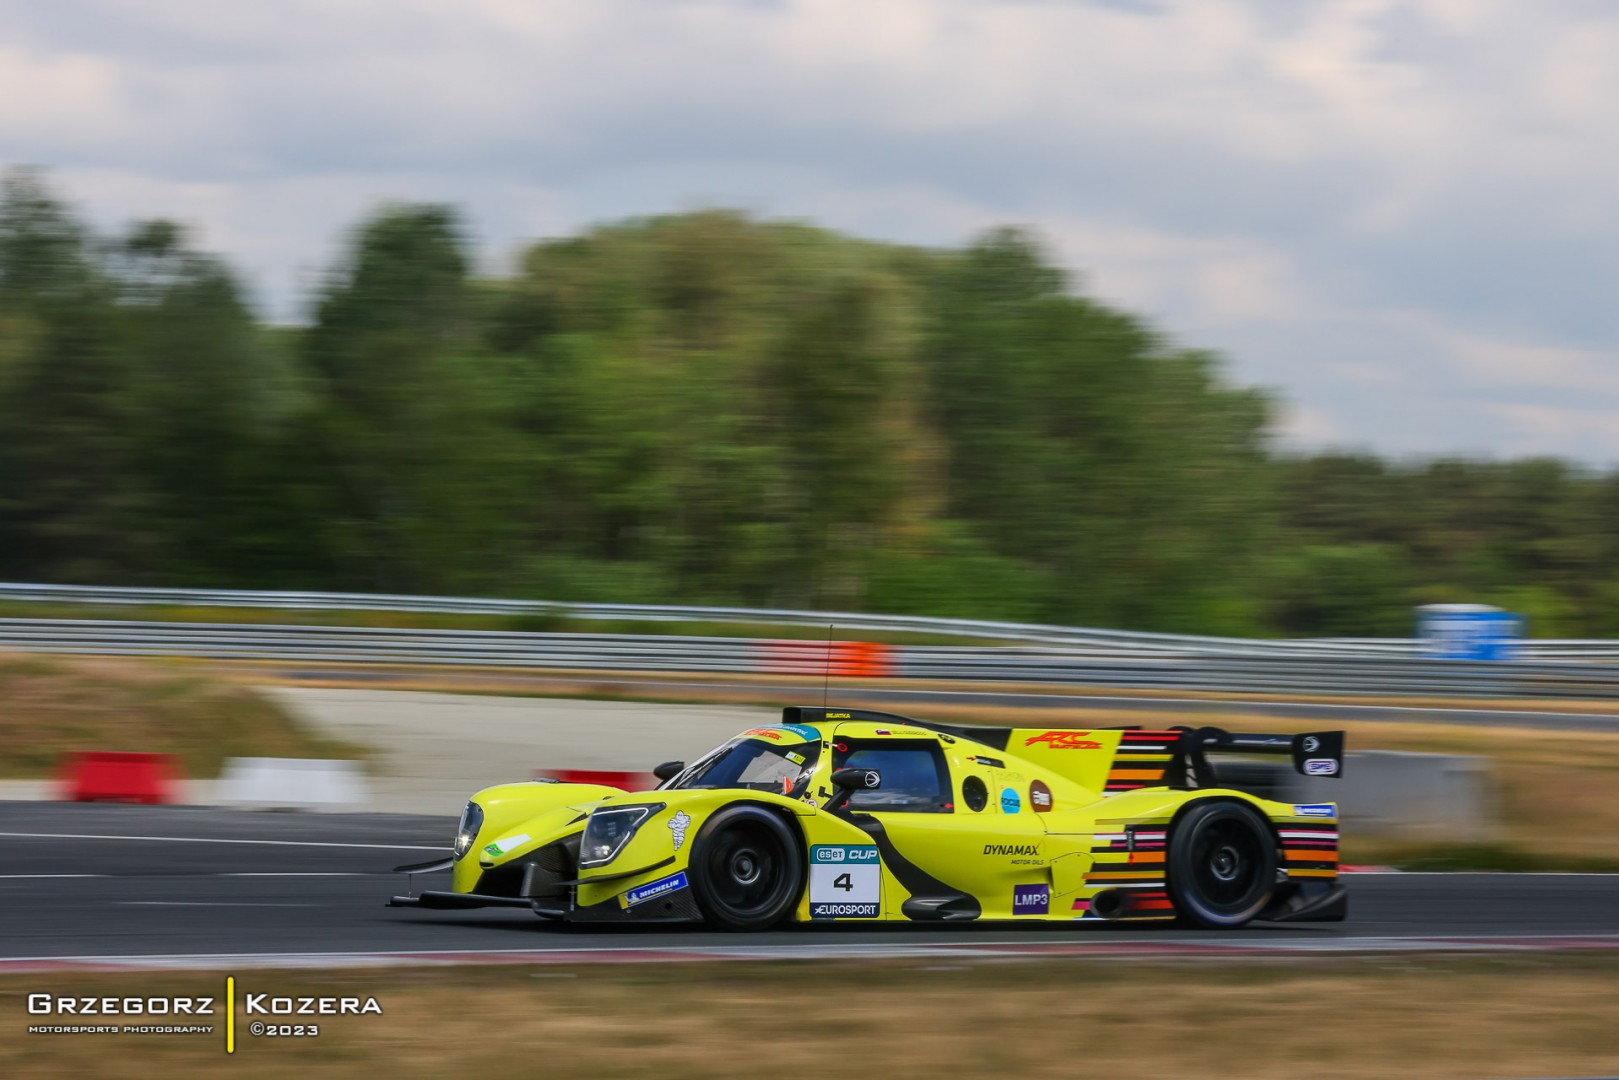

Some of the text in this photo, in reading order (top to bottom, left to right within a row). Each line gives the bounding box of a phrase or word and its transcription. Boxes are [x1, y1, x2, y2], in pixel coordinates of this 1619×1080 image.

[848, 849, 878, 860] CUP
[983, 844, 1040, 856] DYNAMAX
[639, 879, 679, 898] MICHELIN
[833, 873, 854, 892] 4
[1014, 894, 1048, 906] LMP3
[815, 904, 876, 915] EUROSPORT
